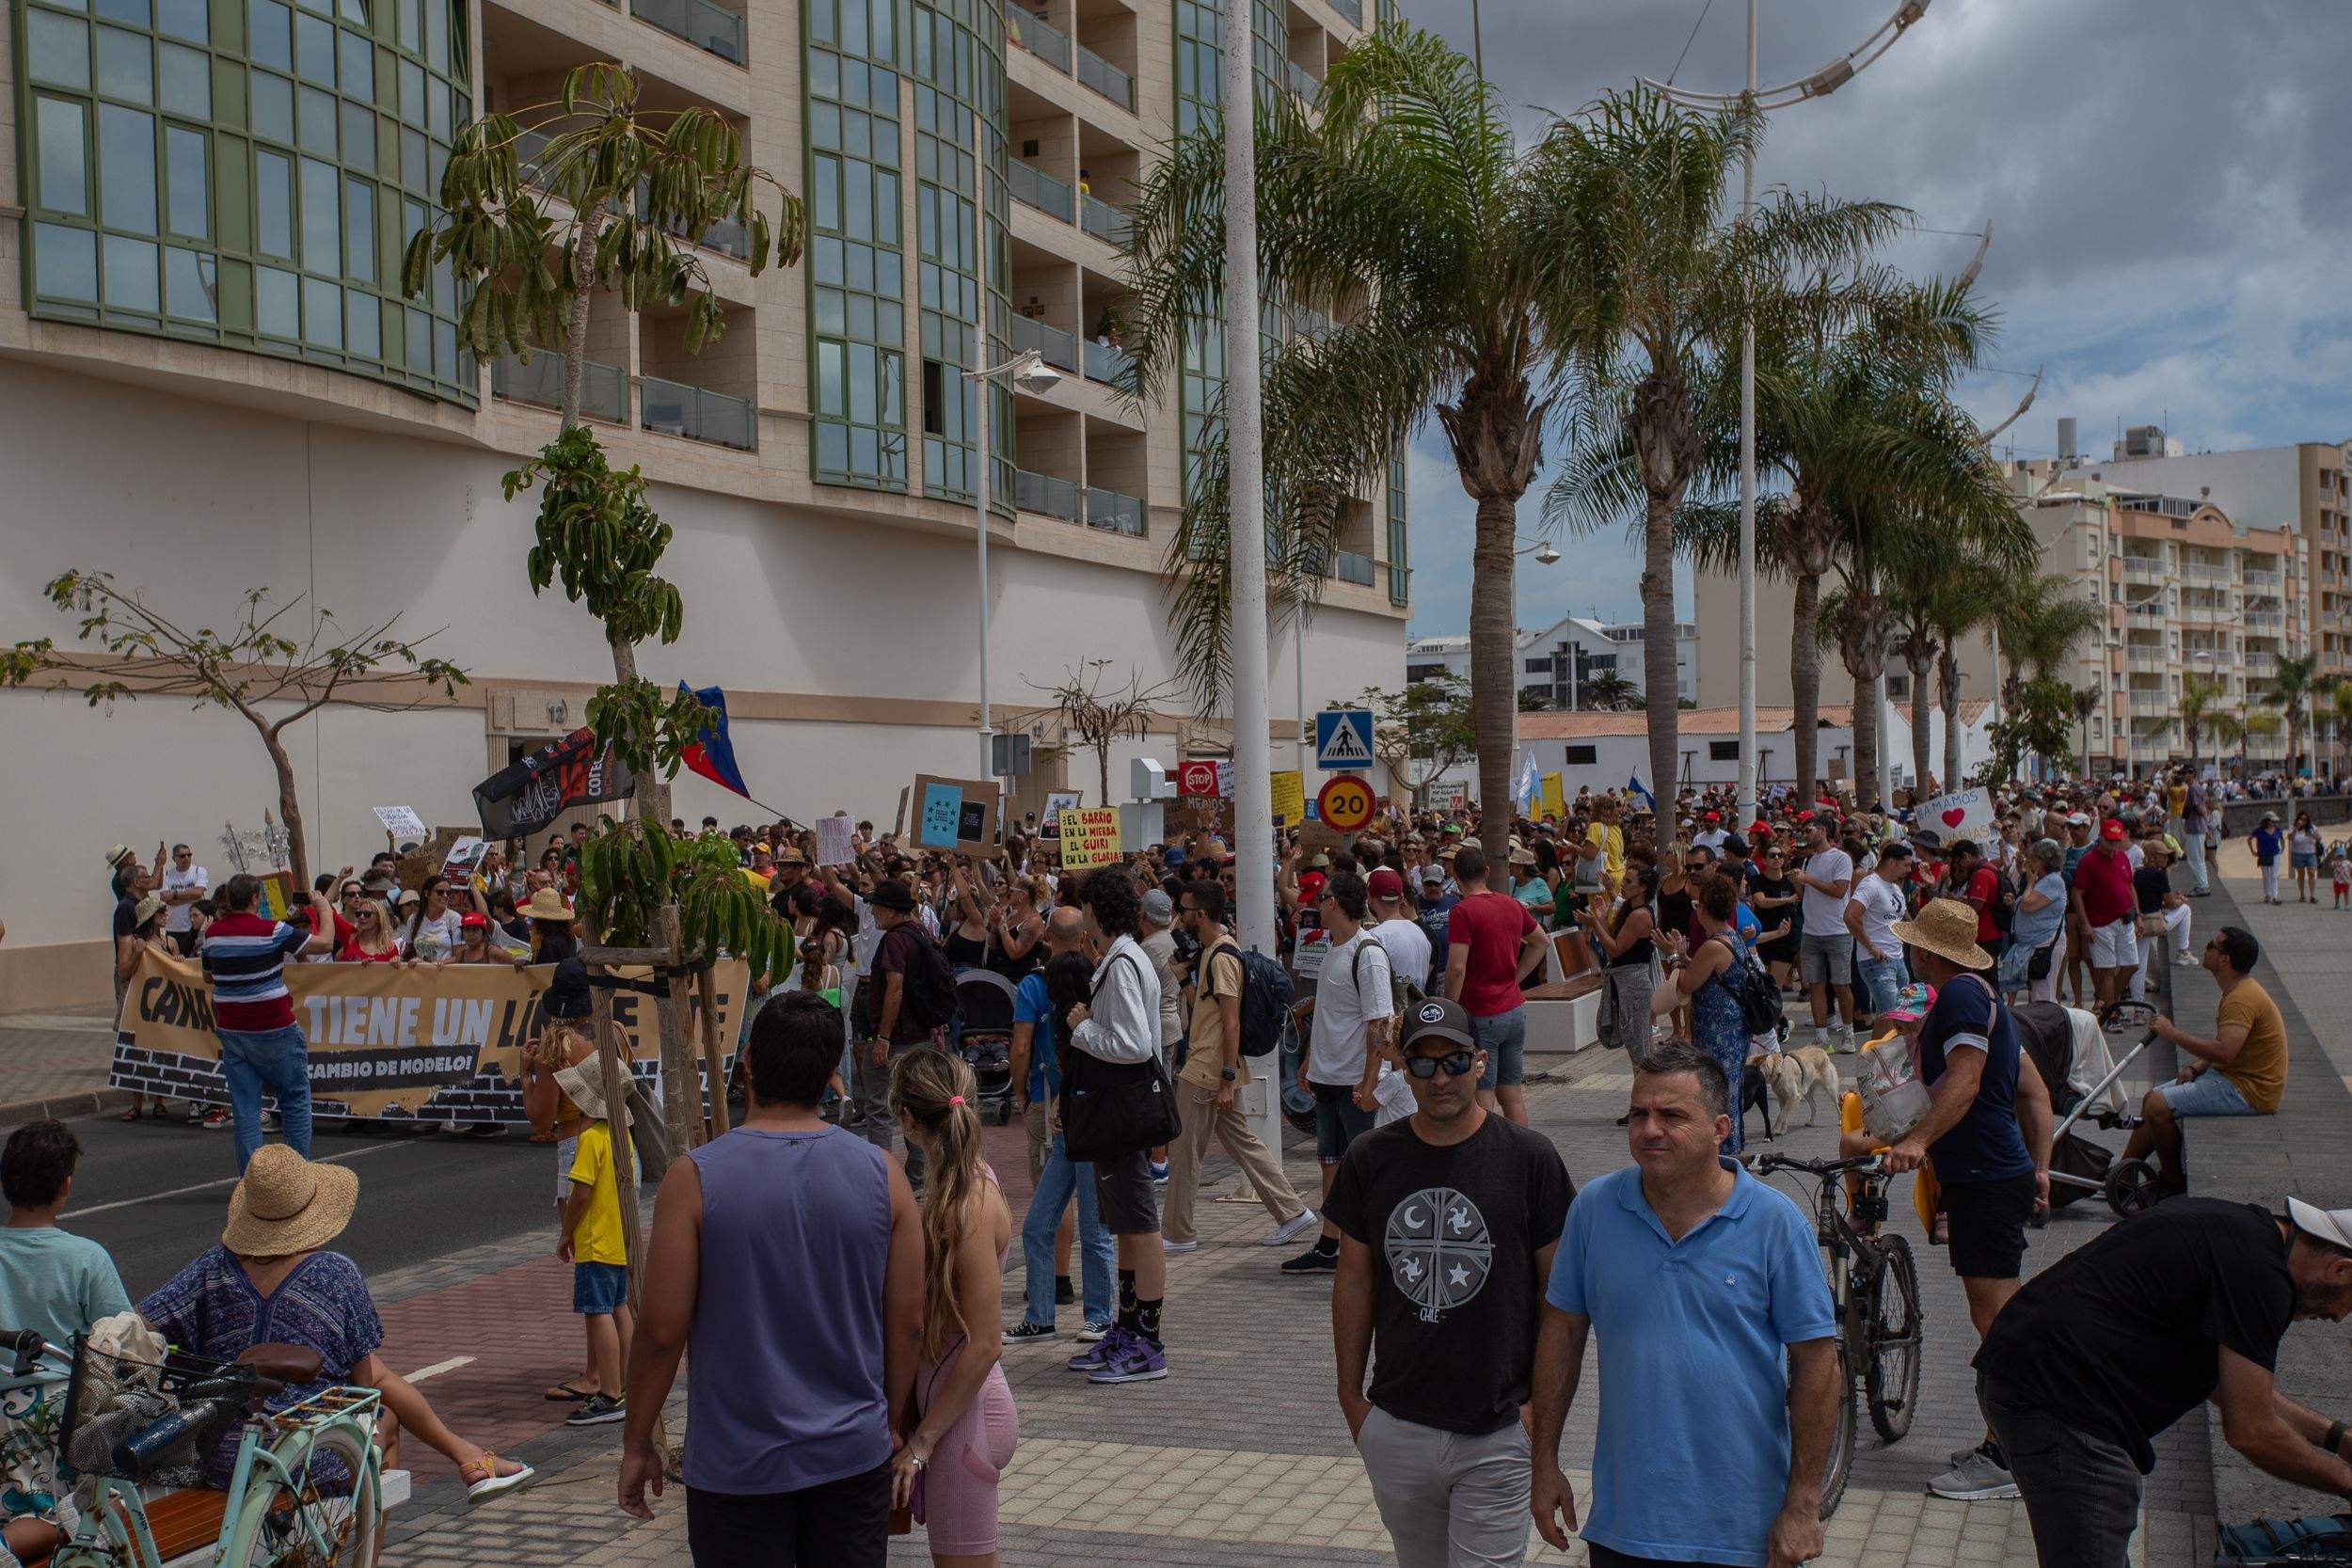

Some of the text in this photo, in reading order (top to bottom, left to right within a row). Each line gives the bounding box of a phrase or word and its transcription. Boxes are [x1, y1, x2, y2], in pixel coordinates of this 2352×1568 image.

[1188, 774, 1211, 786] STOP
[1332, 796, 1364, 815] 20
[1067, 815, 1077, 826] EL
[1081, 811, 1112, 825] BARRIO
[1065, 827, 1117, 837] EN LA MIERDA
[1071, 839, 1108, 851] EL GUIRI
[1065, 855, 1076, 864] EN
[1091, 852, 1120, 863] GLORIA
[140, 976, 217, 1031] CANA
[304, 995, 421, 1046] TIENE
[433, 998, 494, 1048] UN
[307, 1055, 471, 1079] CAMBIO DE MODELO!
[1421, 1307, 1439, 1323] CHILE
